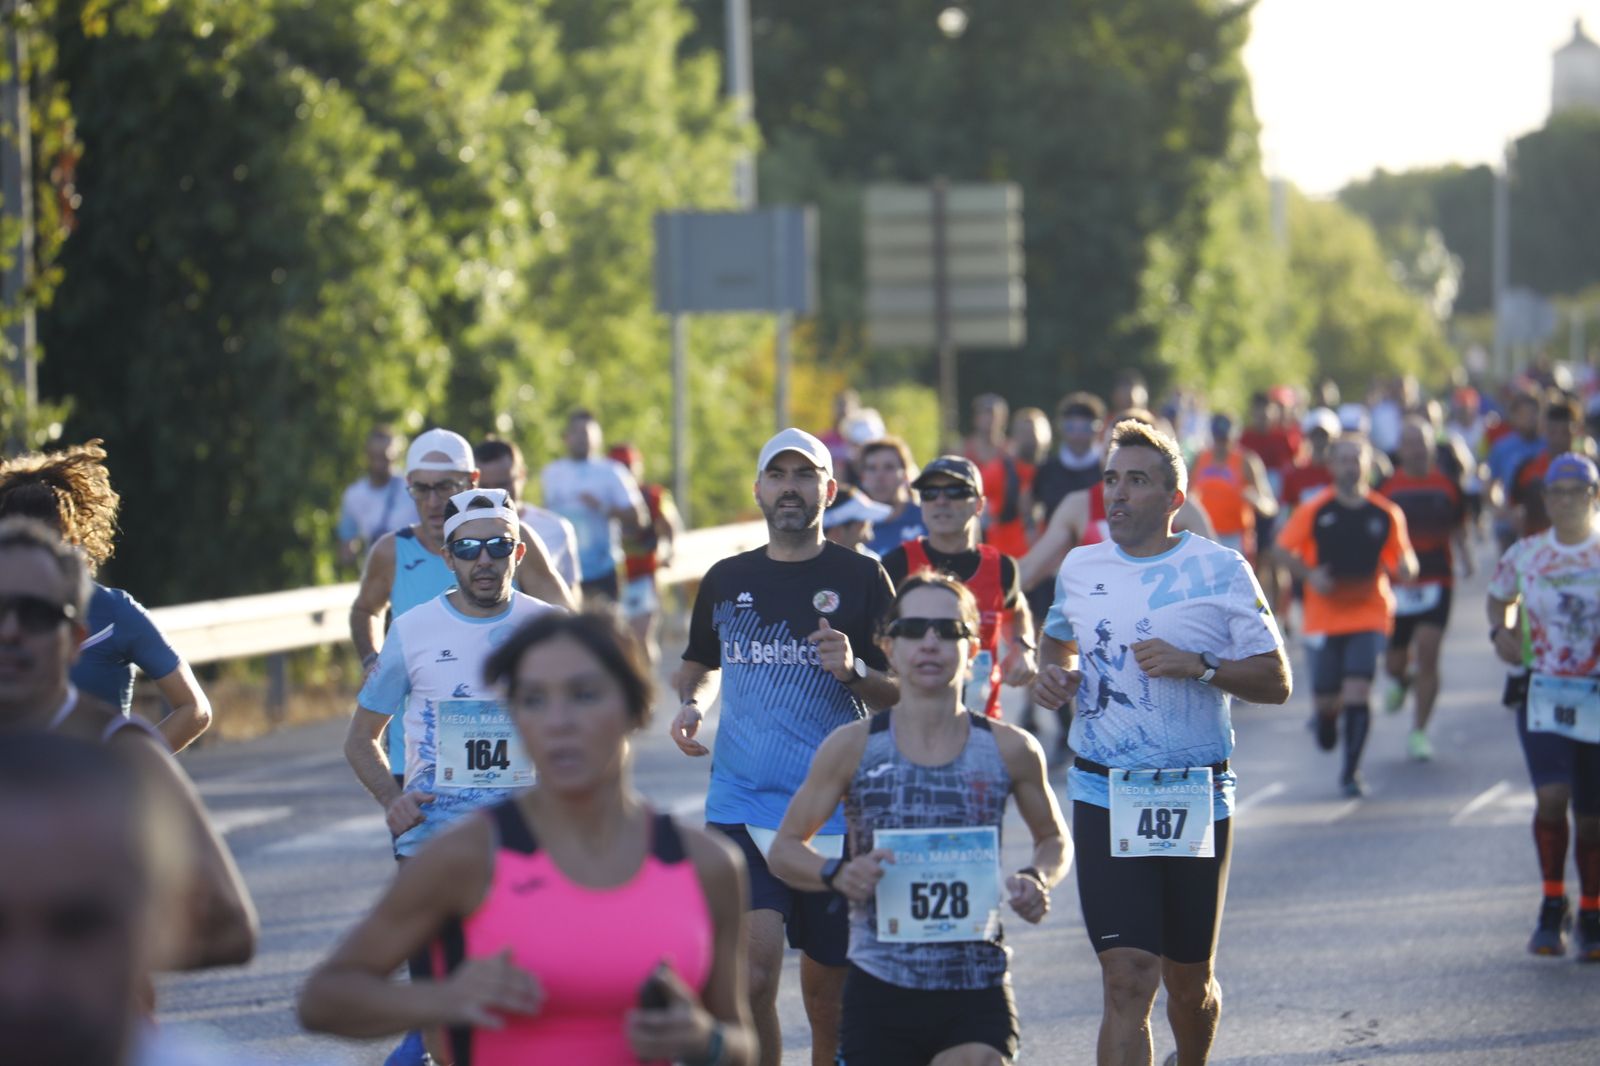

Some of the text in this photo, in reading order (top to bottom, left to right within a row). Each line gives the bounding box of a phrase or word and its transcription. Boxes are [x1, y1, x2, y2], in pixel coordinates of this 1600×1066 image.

[751, 638, 820, 666] Belalcá
[442, 713, 477, 725] MEDIA
[465, 739, 510, 771] 164
[1116, 782, 1209, 795] MEDIA MARATÓN
[1137, 808, 1188, 840] 487
[895, 846, 996, 864] EDIA MARATÓN
[910, 881, 969, 920] 528
